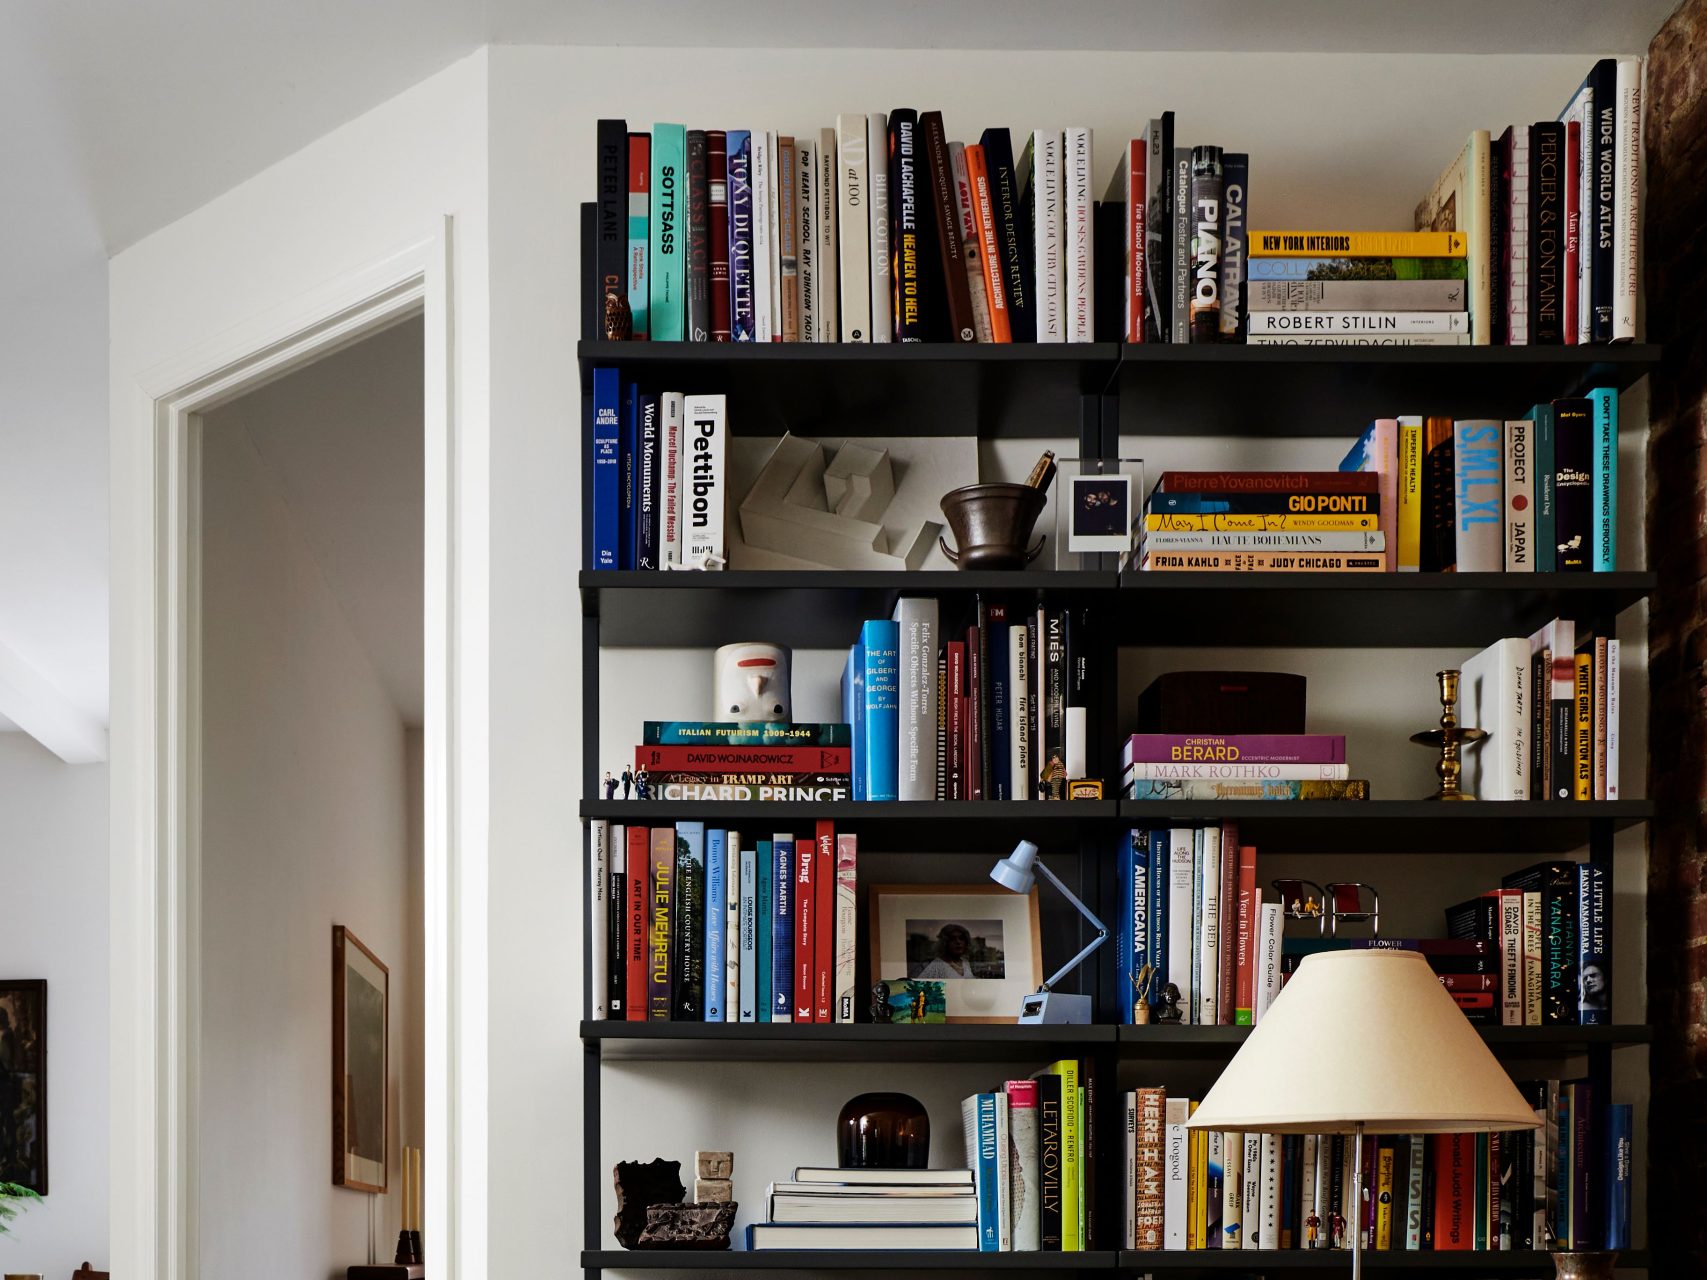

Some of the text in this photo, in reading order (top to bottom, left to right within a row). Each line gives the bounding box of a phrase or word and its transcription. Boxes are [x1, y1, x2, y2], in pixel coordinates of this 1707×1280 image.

[604, 145, 617, 241] PETER LANE
[1600, 108, 1612, 249] WIDE WORLD ATLAS
[1628, 88, 1640, 296] NEW TRADITIONAL ARCHITECTURE
[662, 166, 674, 254] SOTTSASS
[824, 225, 830, 233] TO
[875, 174, 888, 276] BILLY COTTON
[900, 122, 917, 325] DAVID LACHAPELLE HEAVEN TO HELL
[1540, 132, 1557, 322] PERCIER & FONTAINE
[731, 154, 750, 321] TONY DUQUETTE
[998, 167, 1024, 308] INTERIOR DESIGN REVIEW
[1135, 204, 1144, 296] Fire Island Modernist
[1177, 160, 1188, 308] Catalogue Foster and Partners
[1196, 200, 1218, 307] PIANO
[1263, 236, 1349, 251] NEW YORK INTERIORS
[1566, 212, 1577, 254] Man Ray
[1223, 184, 1242, 333] CALATRAVA
[1267, 317, 1396, 328] ROBERT STILIN
[596, 417, 618, 425] ANDRE
[599, 409, 615, 417] CARL
[644, 403, 655, 438] World
[668, 426, 677, 448] Marcel
[642, 442, 654, 512] Monuments
[668, 449, 677, 480] Duchamp:
[692, 420, 715, 527] Pettibon
[1456, 426, 1499, 531] S,M,L,XL
[667, 482, 676, 493] The
[667, 494, 675, 513] Failed
[1288, 495, 1367, 512] GIO PONTI
[1515, 427, 1526, 563] PROJECT JAPAN
[667, 514, 675, 542] Messiah
[1212, 536, 1322, 544] HAUTE BOHEMIANS
[1155, 557, 1219, 567] FRIDA KAHLO
[1270, 558, 1341, 568] JUDY CHICAGO
[909, 622, 918, 653] Specific
[909, 656, 918, 687] Objects
[921, 645, 929, 715] Gonzalez-Torres
[910, 690, 918, 723] Without
[1579, 665, 1588, 779] WHITE GIRLS HILTON ALS
[687, 754, 793, 764] DAVID WOJNAROWICZ
[909, 726, 918, 758] Specific
[1018, 746, 1027, 768] pines
[1171, 747, 1239, 761] BERARD
[1155, 766, 1281, 778] MARK ROTHKO
[649, 786, 846, 801] RICHARD PRINCE
[633, 914, 641, 934] OUR
[634, 901, 641, 910] IN
[654, 861, 668, 983] JULIE MEHRETU
[1134, 865, 1146, 953] AMERICANA
[1207, 896, 1216, 948] THE BED
[1239, 899, 1248, 918] Year
[1239, 920, 1248, 928] in
[1593, 869, 1603, 954] A LITTLE LIFE
[1238, 932, 1248, 966] Flowers
[1550, 899, 1561, 989] YANAGIHARA
[980, 1099, 994, 1159] MUHAMMAD
[1144, 1095, 1159, 1194] HERE I AM
[1043, 1101, 1058, 1213] LETAROVILLY
[1170, 1135, 1182, 1181] Toogood
[1450, 1133, 1461, 1243] Donald Judd Writings
